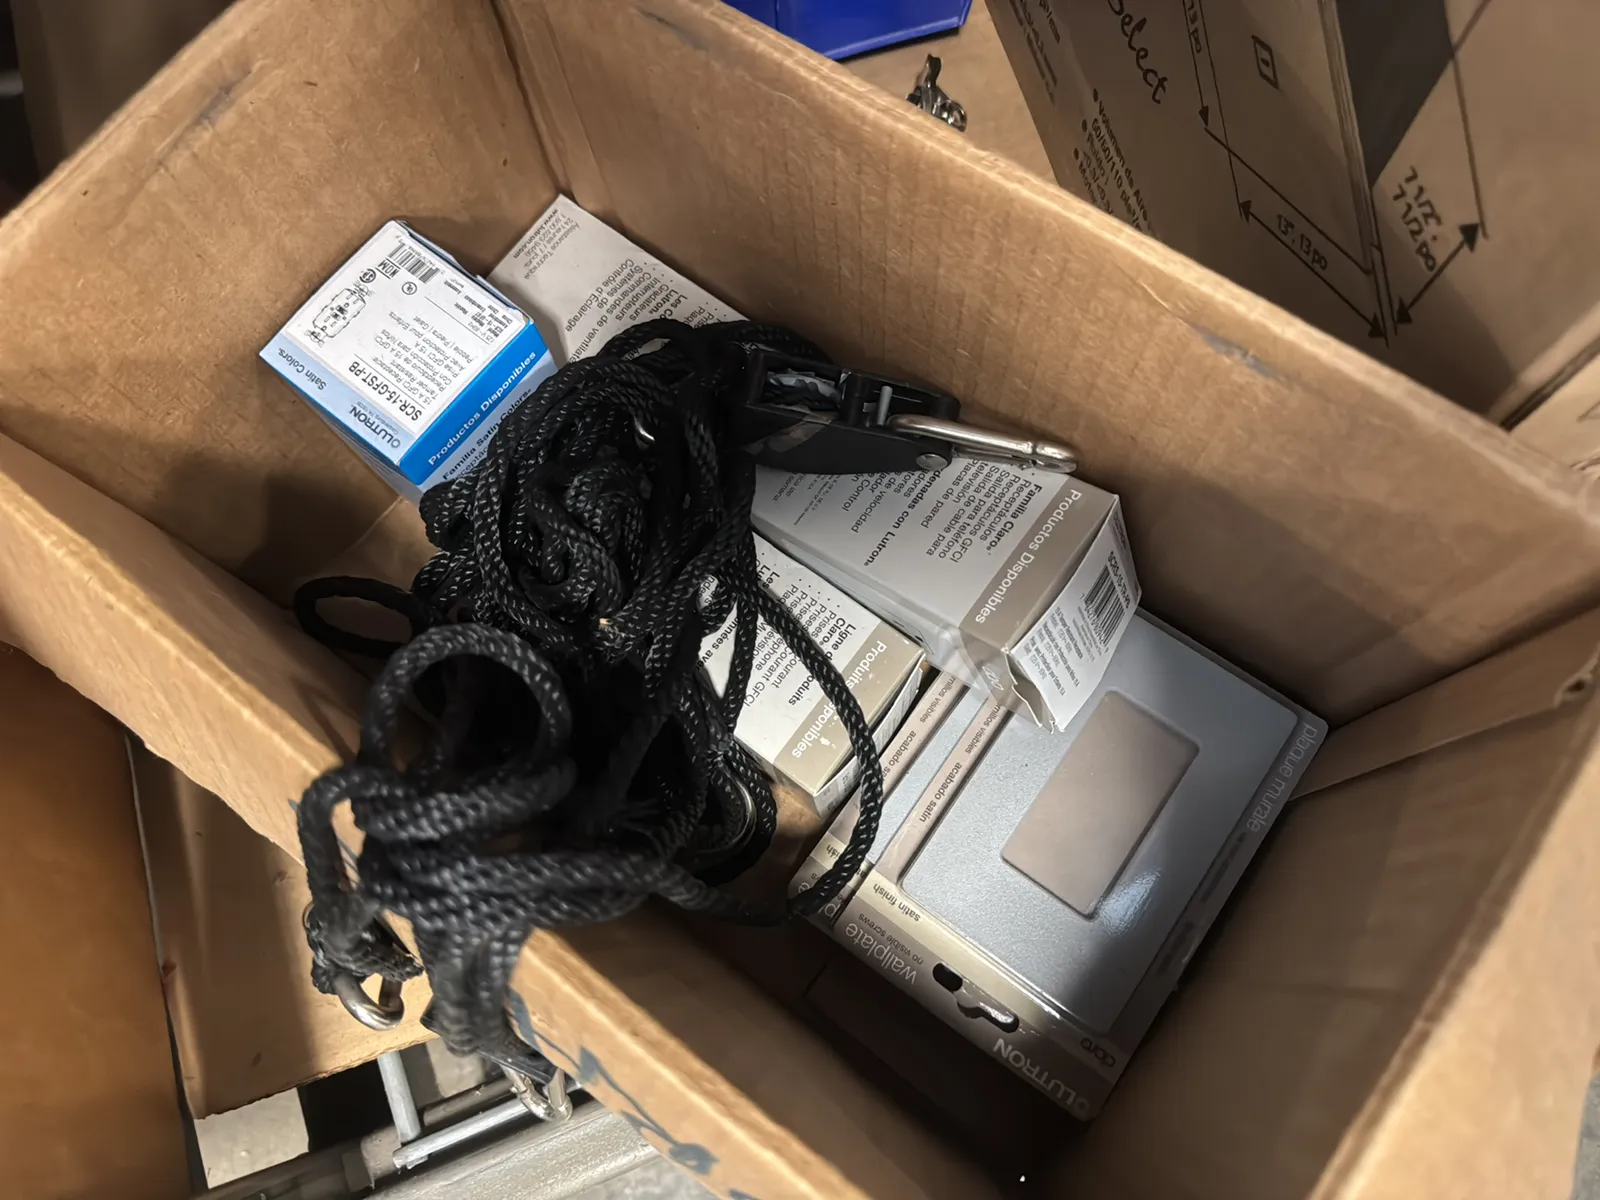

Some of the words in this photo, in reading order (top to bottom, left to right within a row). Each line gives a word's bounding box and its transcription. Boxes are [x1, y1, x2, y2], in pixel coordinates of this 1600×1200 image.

[512, 209, 559, 258] www.lutron.com
[377, 260, 398, 276] NOM
[602, 258, 633, 289] Contrôle
[607, 263, 642, 299] Systèmes
[597, 297, 609, 310] de
[606, 271, 651, 316] Commandes
[614, 276, 659, 321] Interrupteurs
[629, 282, 668, 322] Gradateurs
[671, 294, 686, 309] Les
[388, 312, 409, 329] Enfants
[563, 286, 604, 331] d'Éclairage
[596, 315, 608, 327] de
[683, 305, 704, 327] Plaqu
[409, 327, 422, 338] pour
[693, 311, 713, 333] Prise
[374, 335, 390, 348] GFCI
[393, 349, 404, 359] 15
[397, 340, 411, 352] para
[418, 345, 428, 354] 15
[421, 337, 450, 360] Protection
[453, 346, 473, 362] Pebble
[567, 327, 597, 365] ventilate
[372, 357, 402, 381] Receptacle
[389, 360, 415, 380] Resistant
[401, 356, 413, 366] de
[409, 351, 439, 375] Protección
[427, 352, 444, 366] GFCI
[443, 363, 459, 376] Prise
[449, 358, 464, 370] Avec
[304, 370, 325, 390] Satin
[402, 380, 419, 394] GFCI
[411, 362, 446, 390] Receptáculo
[414, 378, 438, 398] Tamper
[438, 373, 451, 384] Con
[348, 361, 421, 420] SCR-15-GFST-PB
[428, 410, 479, 465] Productos
[480, 350, 536, 411] Disponibles
[443, 446, 475, 479] Familia
[476, 422, 498, 445] Satin
[884, 476, 896, 490] de
[952, 457, 977, 487] Placas
[952, 461, 988, 504] televisión
[973, 465, 999, 495] Salida
[982, 469, 1009, 501] Salida
[841, 478, 870, 511] Control
[907, 467, 943, 510] denadas
[942, 486, 954, 499] de
[963, 494, 976, 508] de
[1010, 483, 1041, 520] Familia
[850, 489, 886, 532] velocidad
[919, 500, 944, 528] pared
[965, 498, 985, 521] para
[968, 473, 1020, 537] Receptáculos
[978, 478, 1030, 542] Receptáculos
[892, 510, 909, 529] con
[943, 507, 966, 534] cable
[1025, 487, 1081, 551] Productos
[925, 533, 945, 556] para
[937, 520, 970, 559] teléfono
[949, 536, 972, 563] GFCI
[761, 571, 778, 590] Les
[971, 549, 1034, 626] Disponibles
[777, 583, 797, 606] Plaq
[785, 591, 807, 616] Prise
[801, 603, 826, 631] Prises
[811, 610, 835, 638] Prises
[711, 616, 741, 649] onnées
[750, 628, 776, 659] lévisio
[830, 623, 855, 651] Ligne
[754, 637, 784, 671] éphone
[762, 646, 791, 680] Courant
[824, 650, 834, 660] d
[843, 640, 885, 688] Produits
[743, 681, 764, 705] GFCI
[787, 674, 814, 705] oduits
[920, 697, 940, 723] visibles
[983, 702, 1002, 726] ornillos
[789, 700, 837, 758] sponibles
[965, 727, 985, 753] visibles
[888, 731, 916, 766] acabado
[1276, 723, 1318, 779] plaque
[934, 762, 962, 800] acabado
[1245, 777, 1287, 832] murale
[824, 844, 839, 859] ish
[871, 883, 898, 905] finish
[896, 901, 920, 922] satin
[857, 913, 886, 937] screws
[841, 919, 921, 984] wallplate
[885, 934, 912, 956] visible
[912, 953, 923, 964] no
[992, 1038, 1076, 1102] LUTRON
